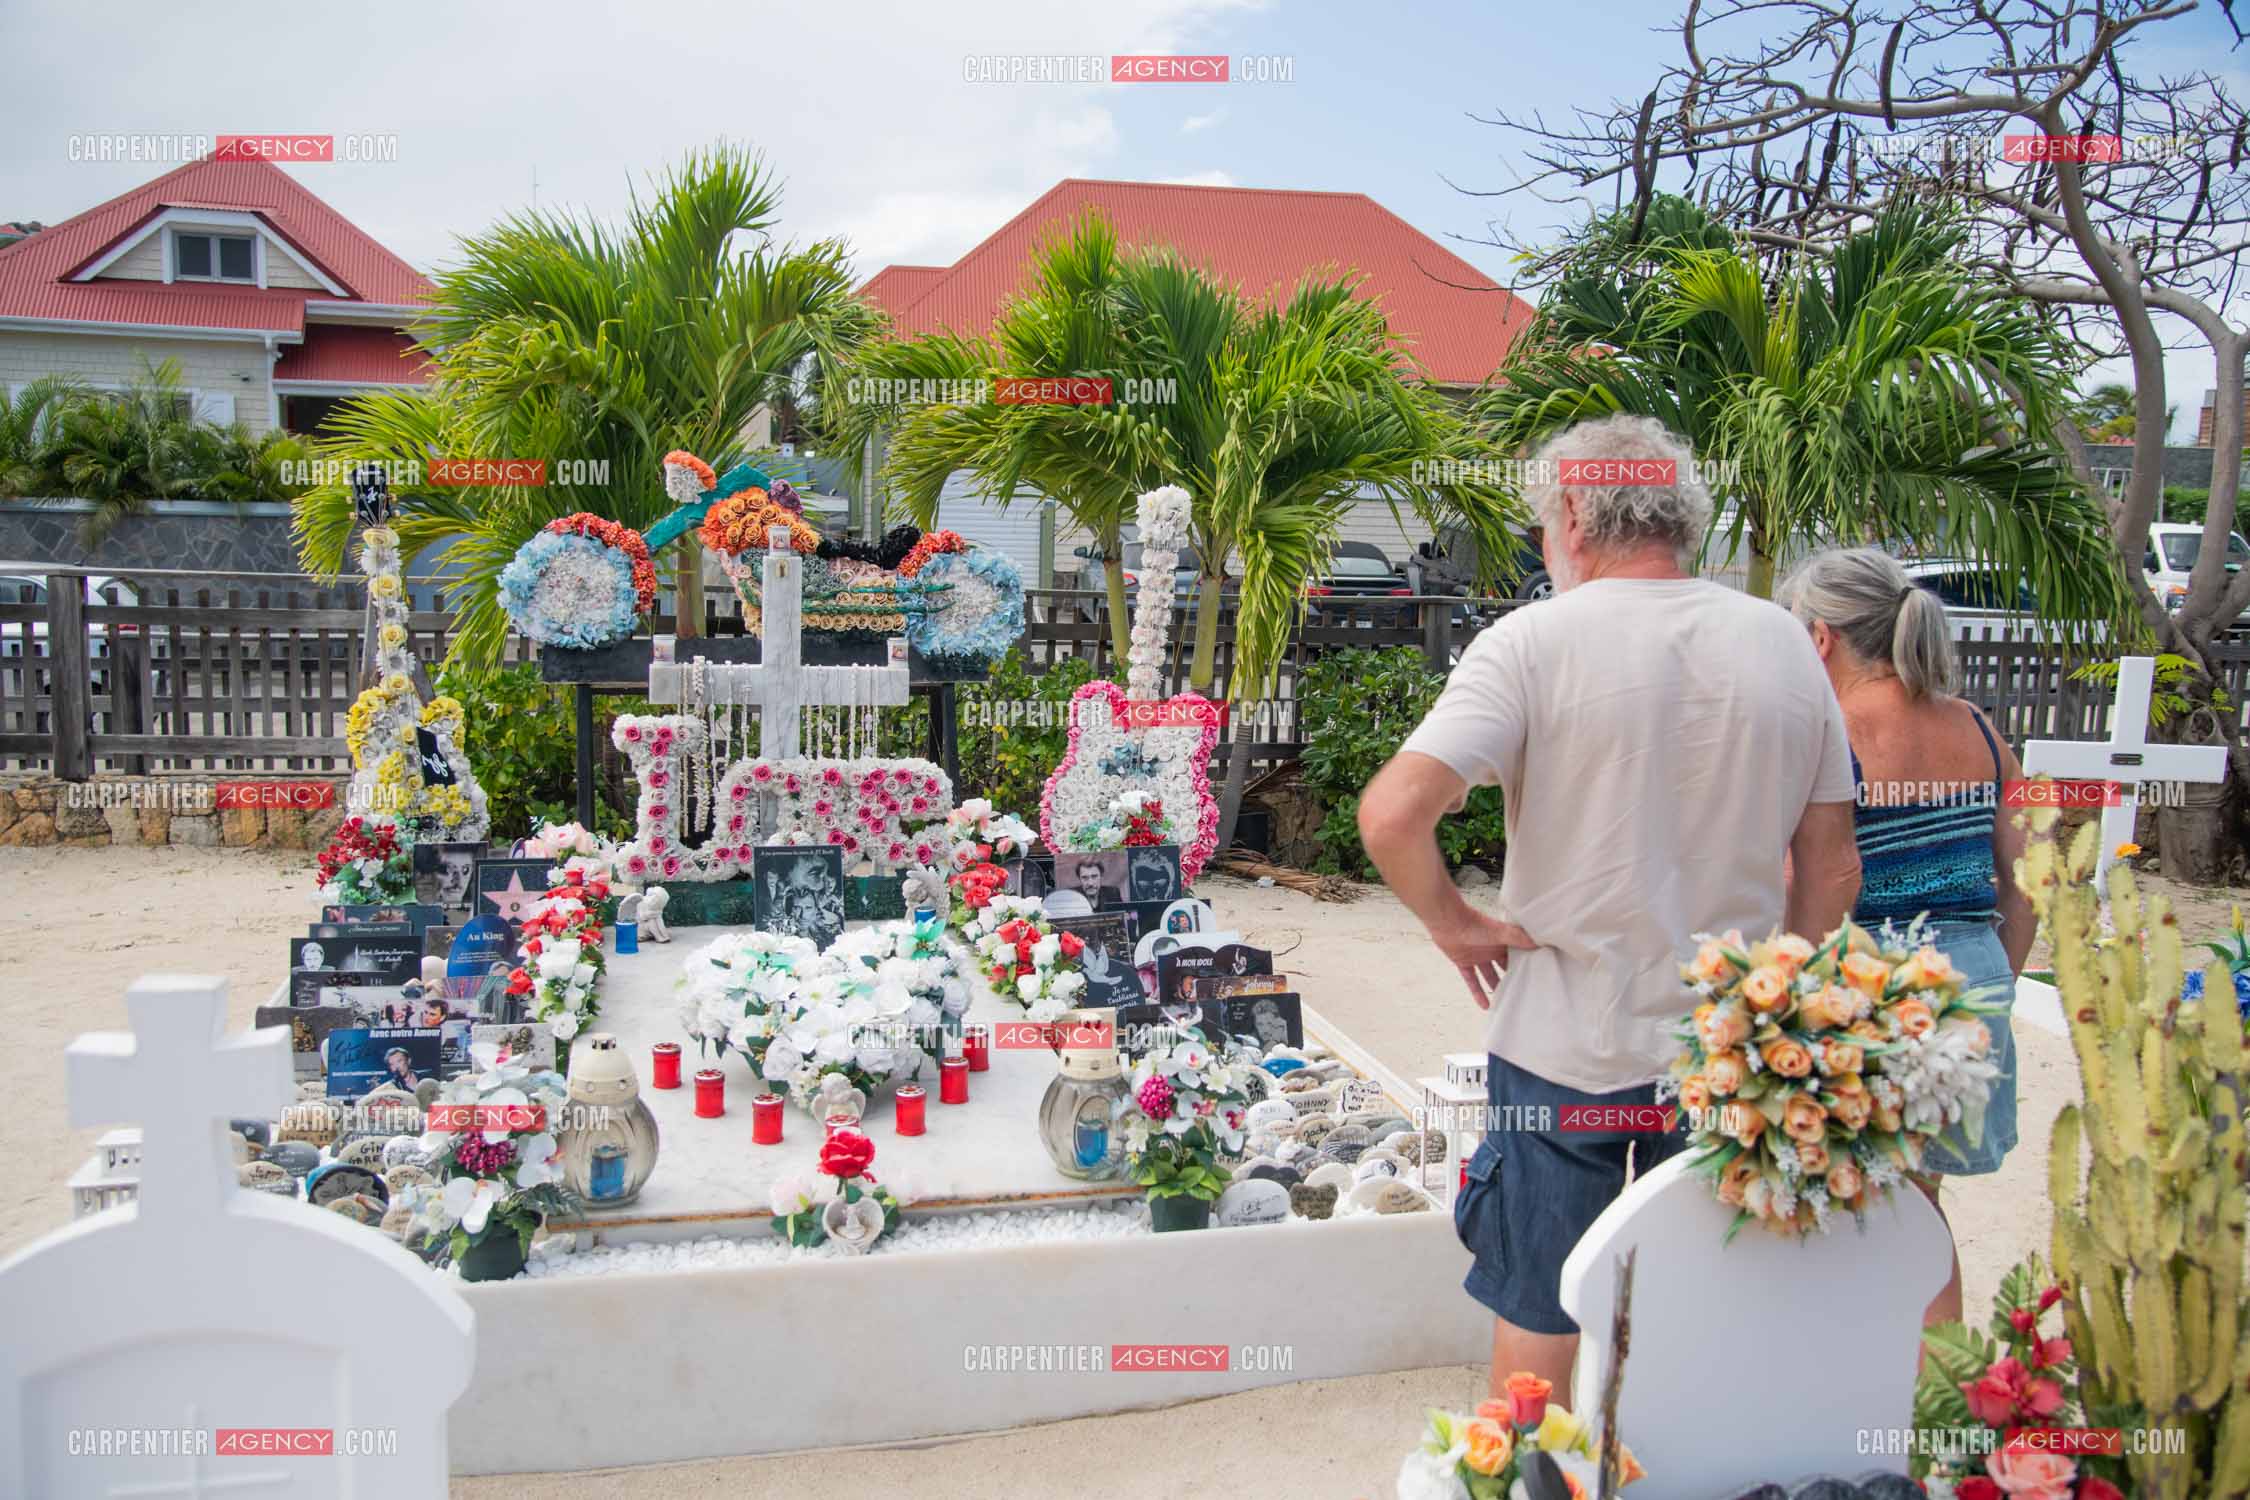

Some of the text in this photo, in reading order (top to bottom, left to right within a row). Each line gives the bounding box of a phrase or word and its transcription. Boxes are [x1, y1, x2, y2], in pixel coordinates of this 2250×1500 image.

[482, 931, 505, 942] King
[369, 1028, 441, 1039] Avec notre Amour
